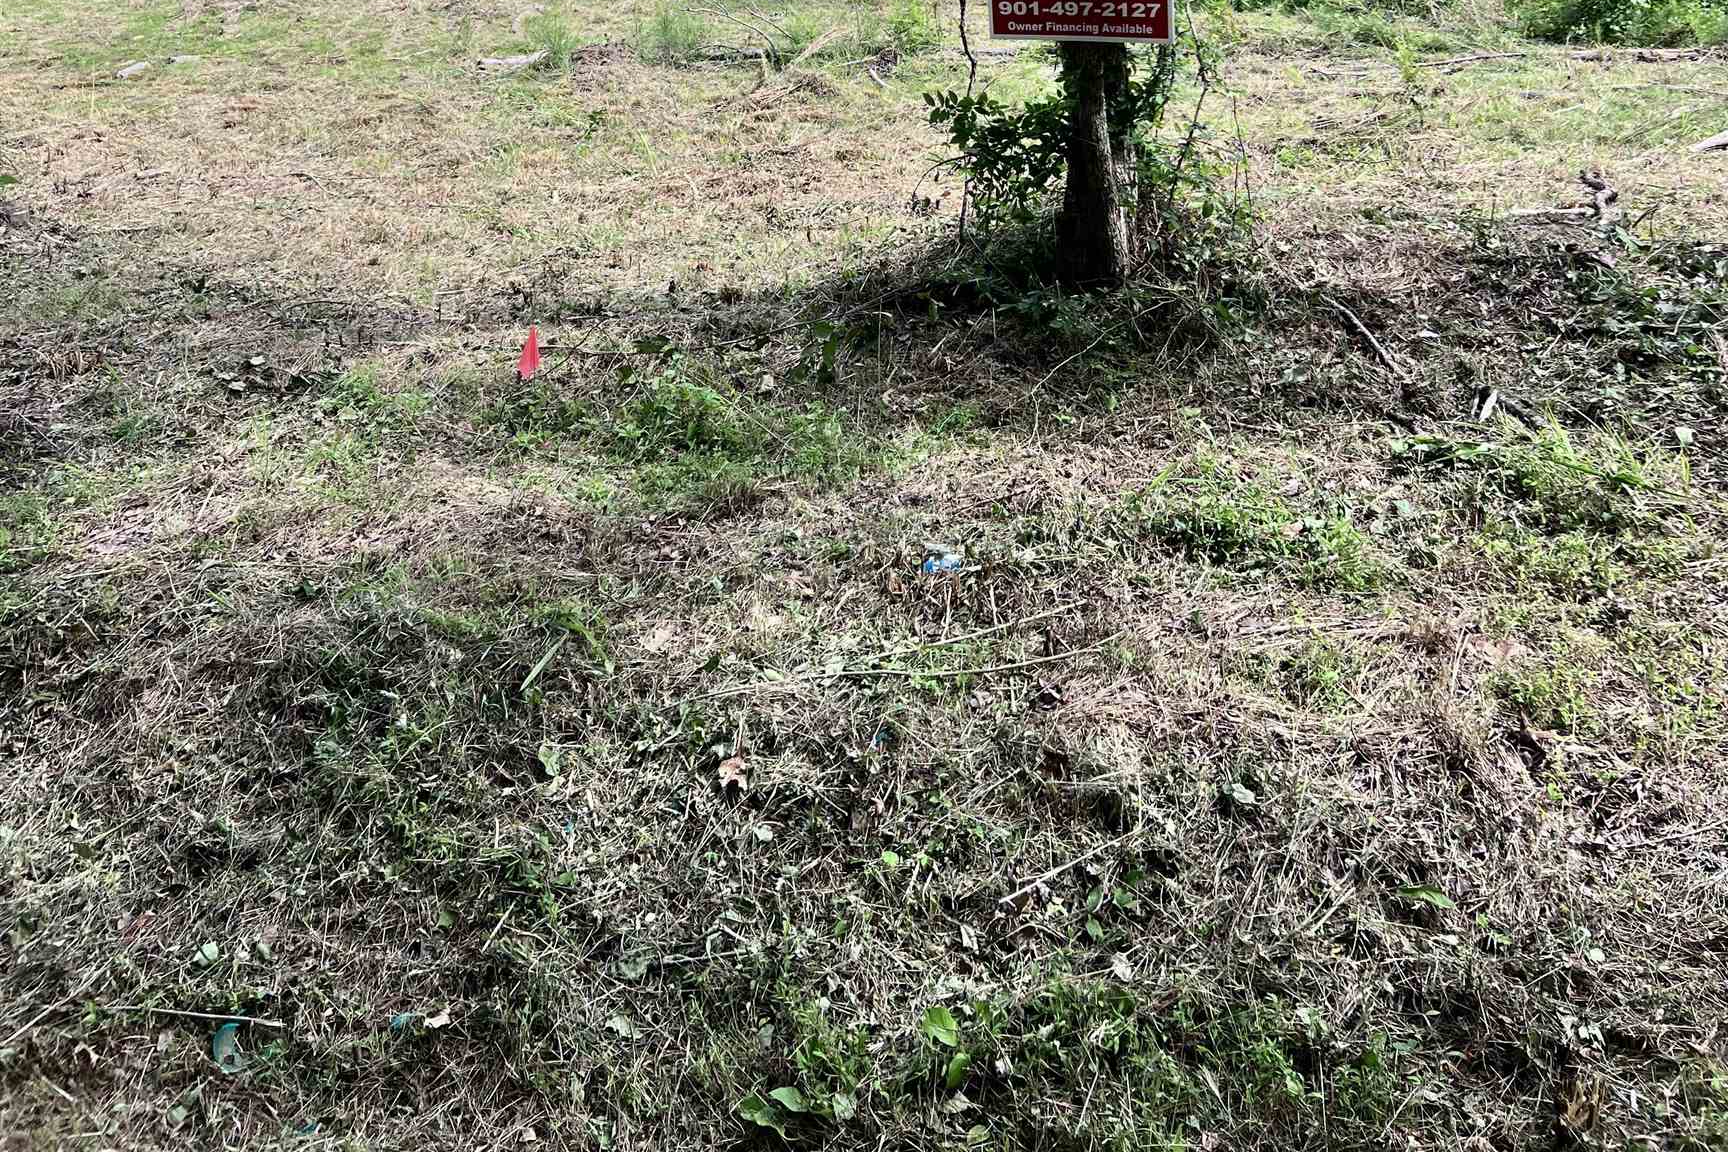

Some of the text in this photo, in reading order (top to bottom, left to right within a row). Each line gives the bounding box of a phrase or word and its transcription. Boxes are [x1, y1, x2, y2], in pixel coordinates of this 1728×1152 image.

[998, 1, 1161, 18] 901-497-2127
[1007, 21, 1153, 35] Owner Financing Available
